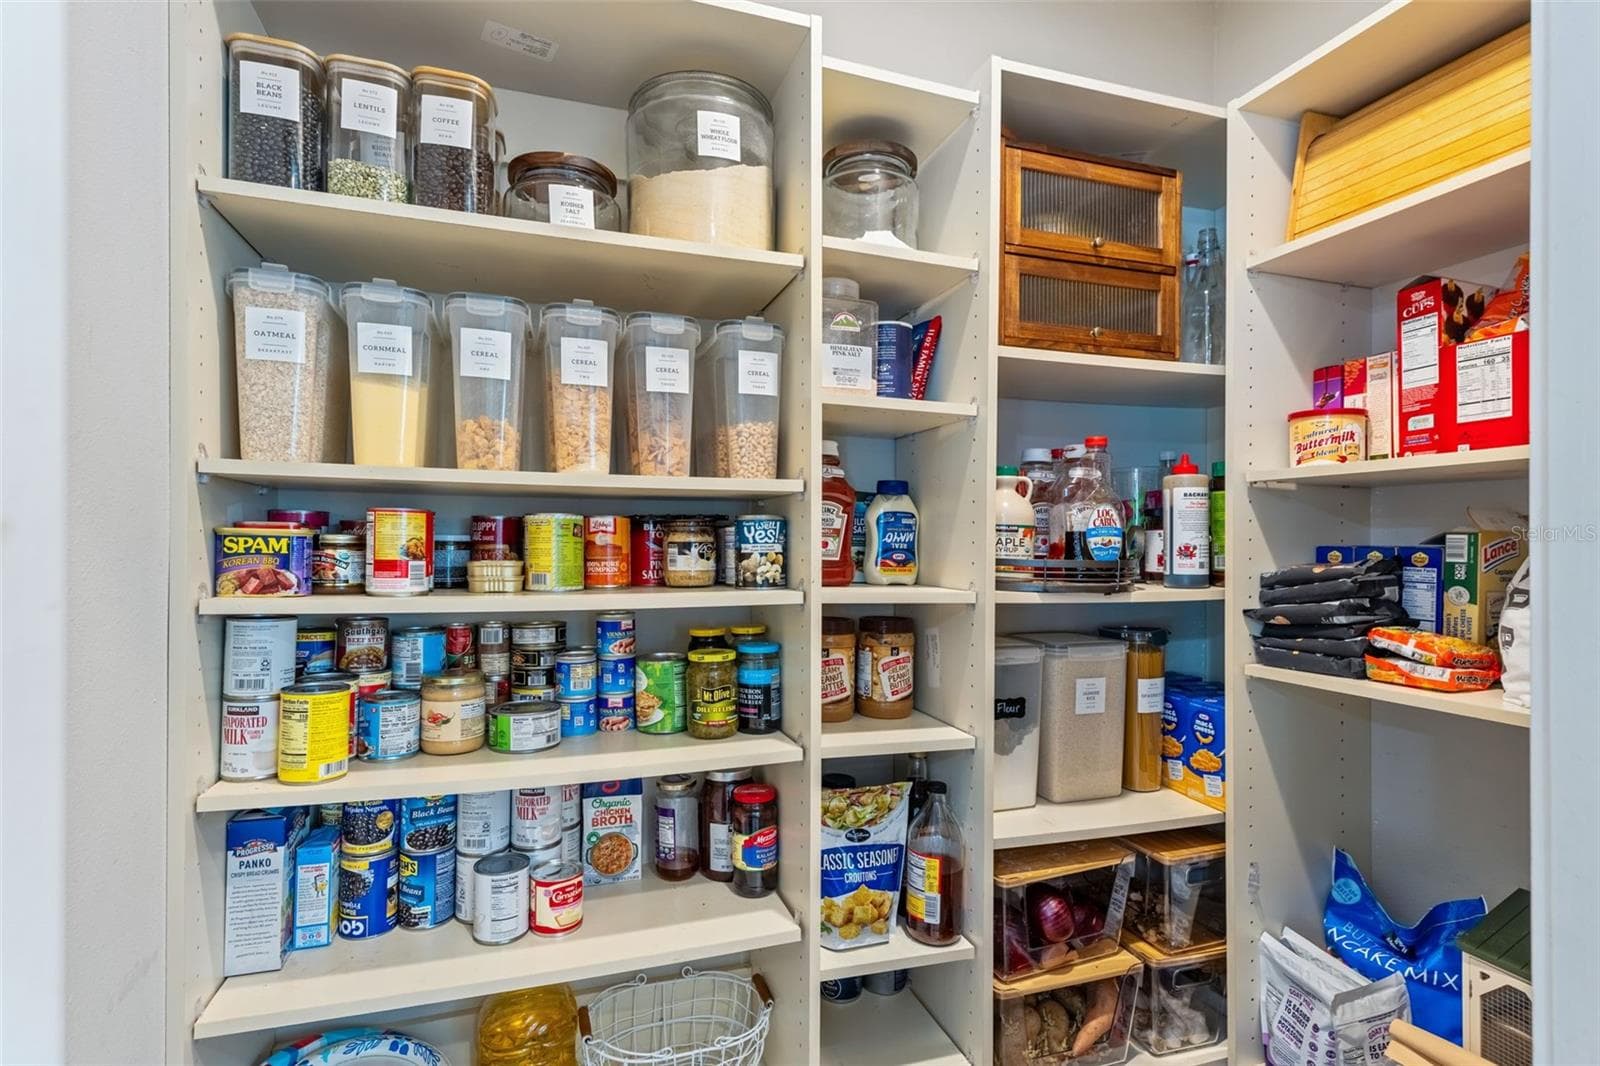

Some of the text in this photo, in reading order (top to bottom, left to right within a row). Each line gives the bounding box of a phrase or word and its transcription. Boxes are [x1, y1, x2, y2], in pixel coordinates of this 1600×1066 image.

[256, 82, 283, 92] BLACK
[256, 89, 283, 99] BEANS
[353, 102, 386, 114] LENTILS
[431, 117, 460, 126] COFFEE
[710, 128, 731, 136] WHOLE
[560, 201, 584, 209] KOSHER
[564, 207, 580, 215] SALT
[1402, 297, 1435, 319] CUPS
[253, 330, 297, 340] OATMEAL
[362, 344, 407, 354] CORNMEAL
[570, 359, 597, 367] CEREAL
[1303, 425, 1339, 440] cultured
[1295, 430, 1356, 455] Buttermilk
[1315, 447, 1340, 458] blend
[1096, 508, 1114, 519] LOG
[1092, 517, 1117, 528] CABIN
[744, 521, 782, 544] Yes!
[882, 531, 914, 543] MAYO
[222, 535, 291, 555] SPAM
[1483, 541, 1518, 564] Lance
[222, 556, 280, 569] KOREAN BBQ
[587, 565, 620, 574] PUMPKIN
[703, 689, 730, 702] Mt. Olive
[996, 702, 1020, 715] Flour
[591, 797, 632, 812] Organic
[411, 809, 434, 821] Black
[593, 808, 632, 819] CHICKEN
[591, 814, 634, 828] BROTH
[236, 843, 275, 857] PROGRESSO
[238, 857, 272, 870] PANKO
[844, 871, 878, 884] CROUTONS
[1404, 966, 1460, 992] MIX
